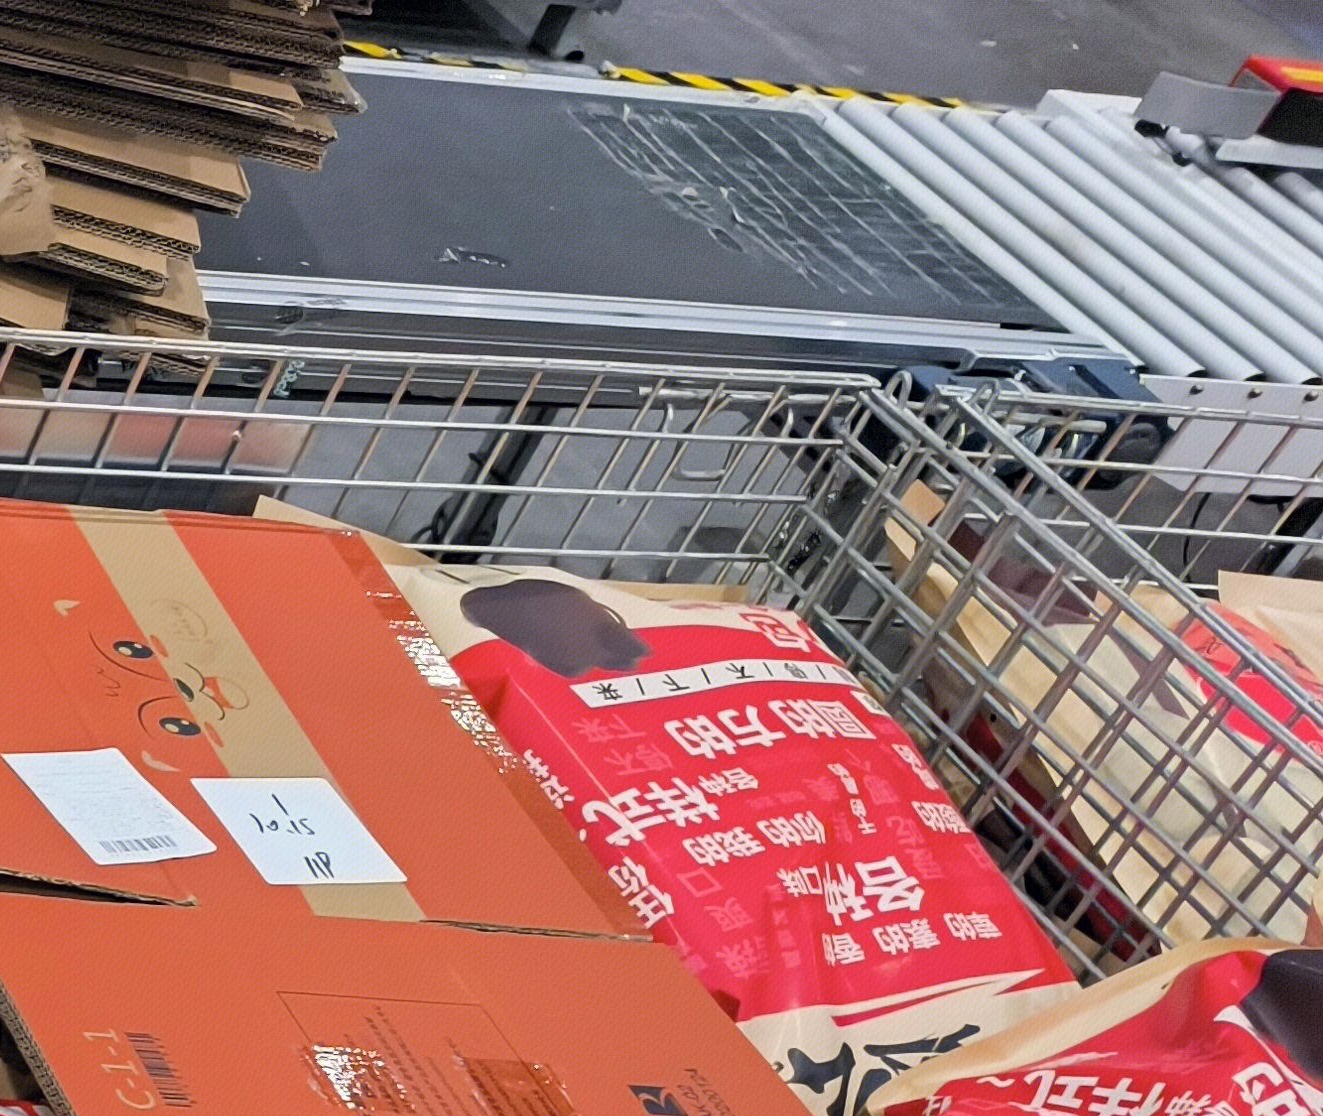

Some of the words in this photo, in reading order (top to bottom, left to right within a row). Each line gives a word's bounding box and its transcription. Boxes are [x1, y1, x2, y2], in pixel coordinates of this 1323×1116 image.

[682, 826, 764, 867] 我的
[757, 809, 827, 850] 你的
[822, 855, 925, 926] 各种
